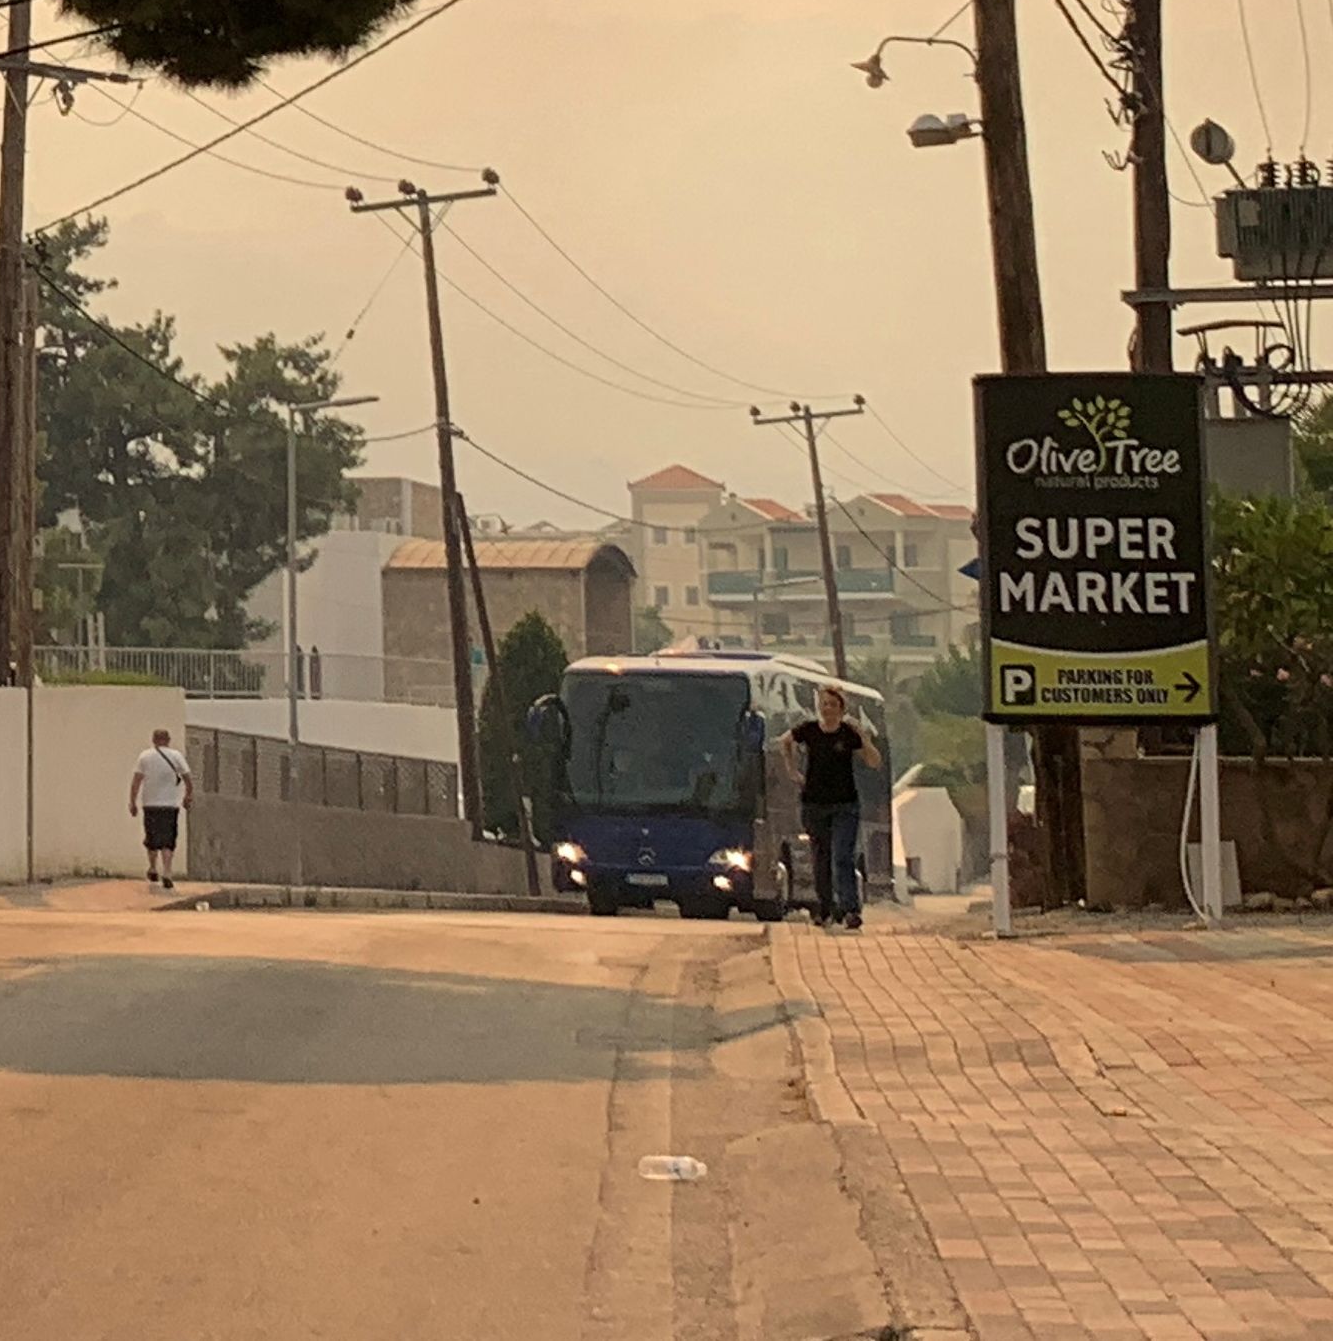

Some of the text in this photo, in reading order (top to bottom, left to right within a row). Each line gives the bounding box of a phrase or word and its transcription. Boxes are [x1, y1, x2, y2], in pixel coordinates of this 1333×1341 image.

[1006, 436, 1182, 474] Olive Tree
[1094, 473, 1160, 491] products
[1015, 517, 1177, 560] SUPER
[999, 571, 1196, 614] MARKET
[1004, 668, 1032, 703] P
[1057, 669, 1154, 685] PARKING FOR
[1041, 688, 1169, 704] CUSTOMERS ONLY
